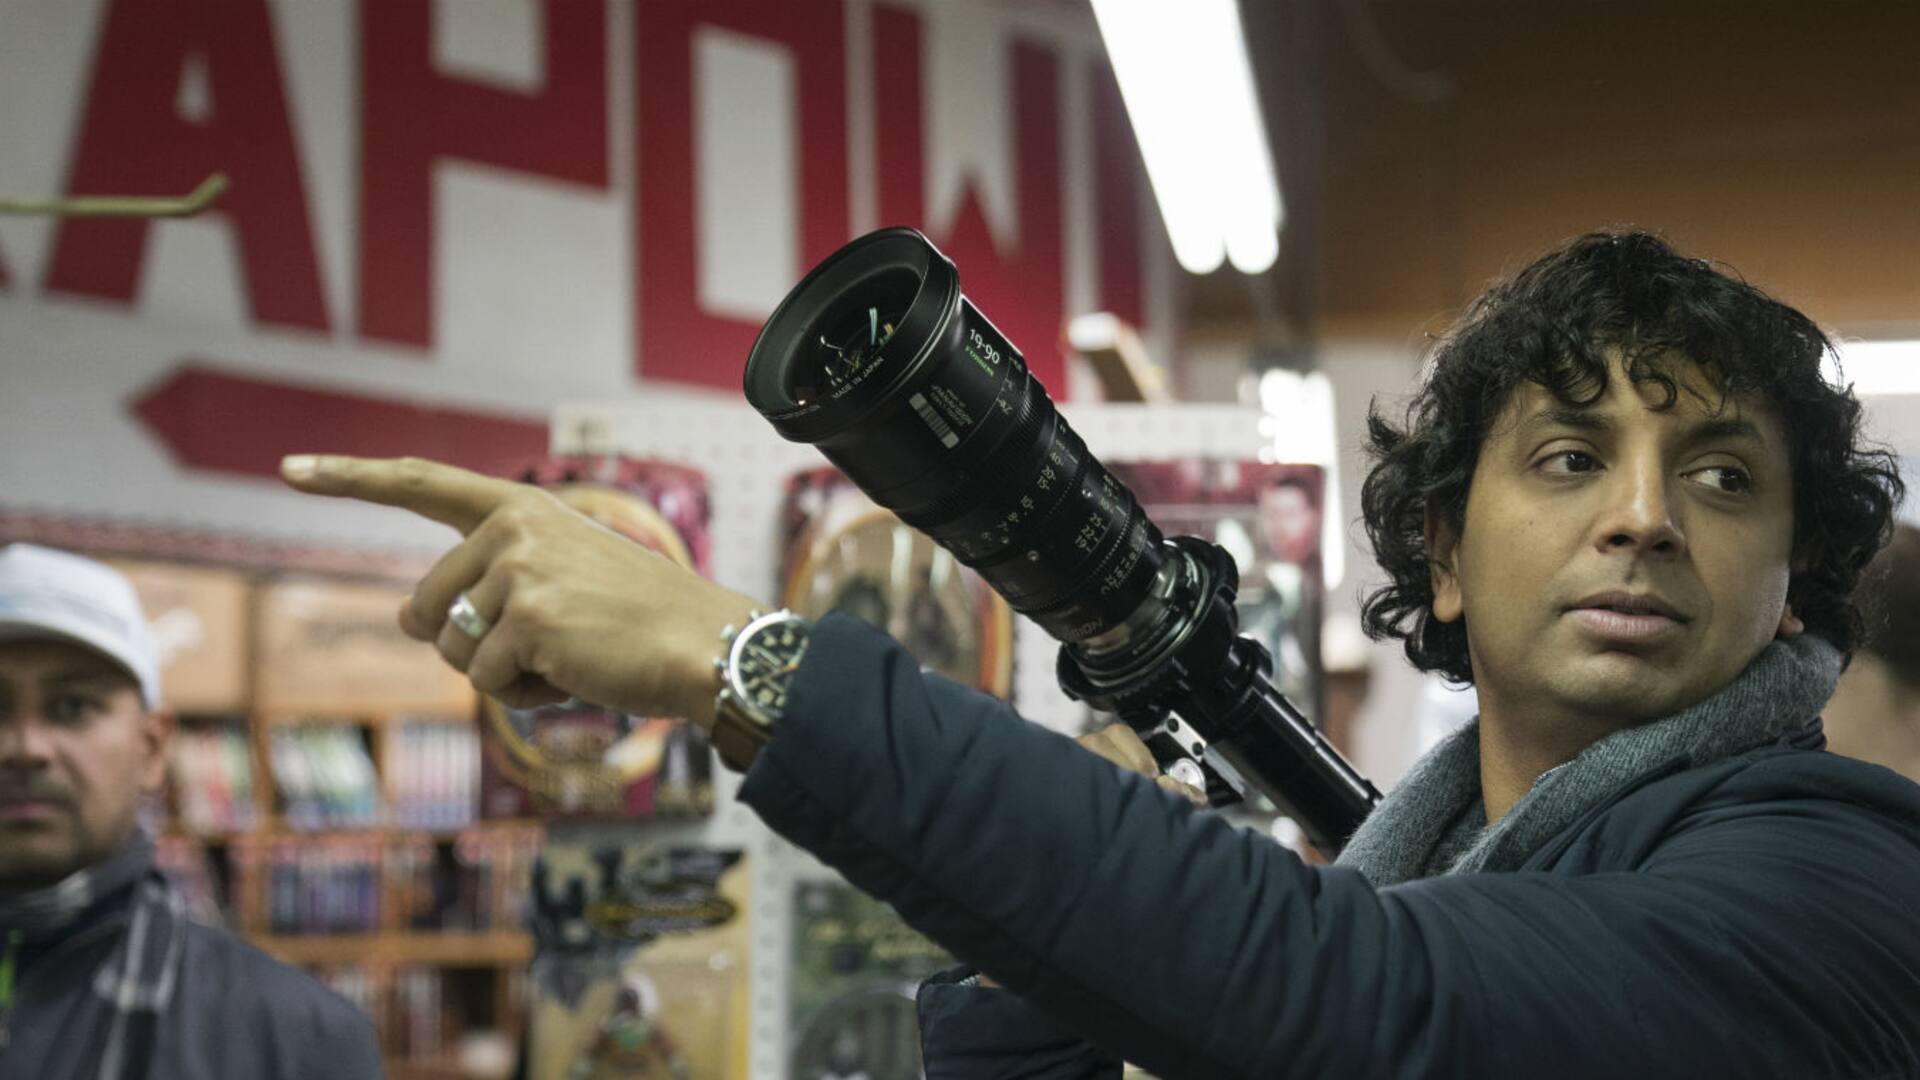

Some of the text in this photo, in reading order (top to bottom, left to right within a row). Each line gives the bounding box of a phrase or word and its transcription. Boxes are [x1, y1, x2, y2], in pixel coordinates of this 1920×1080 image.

[969, 328, 1001, 365] 19-90
[832, 356, 885, 399] MADE IN JAPAN
[1090, 512, 1102, 527] 25
[1081, 525, 1095, 538] 22
[1075, 536, 1087, 548] 19
